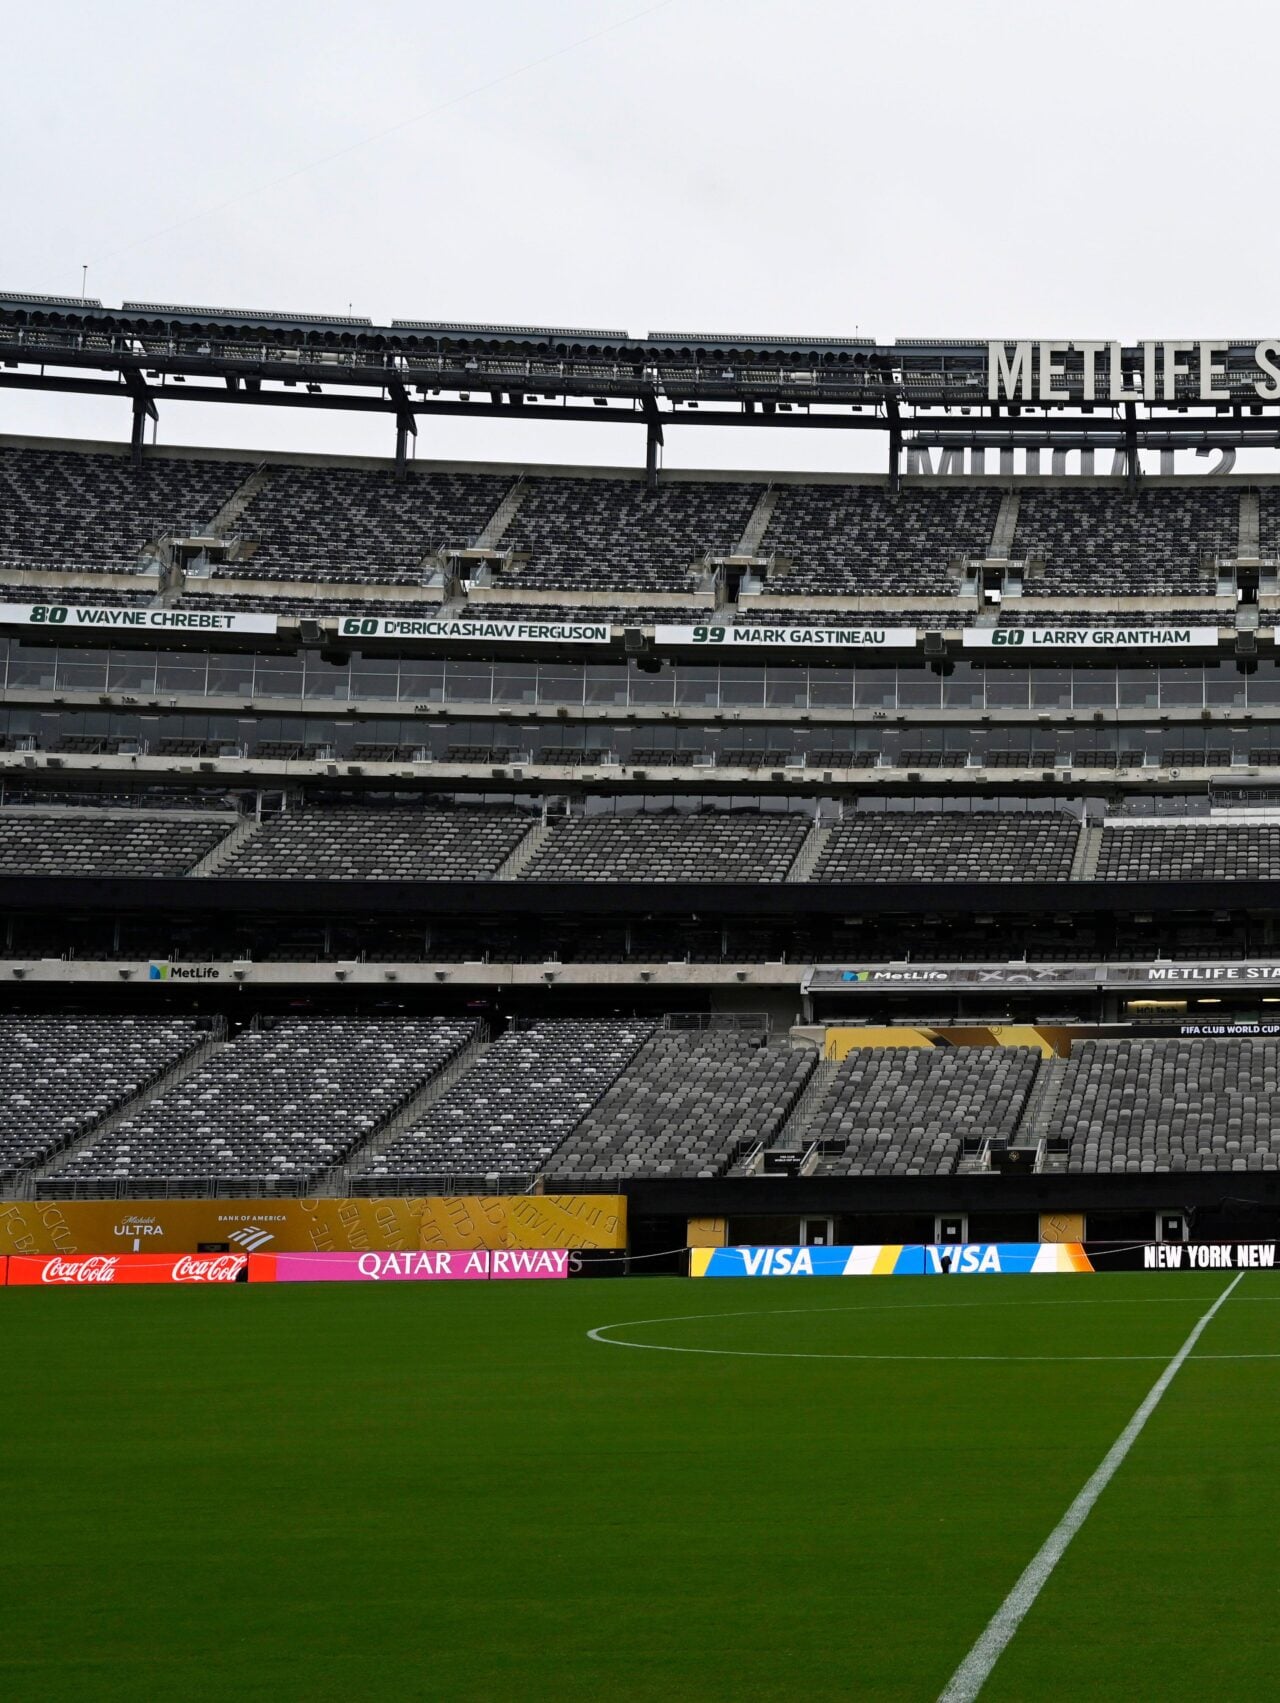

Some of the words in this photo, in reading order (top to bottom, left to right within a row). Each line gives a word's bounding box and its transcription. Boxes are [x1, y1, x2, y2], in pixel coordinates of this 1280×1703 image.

[987, 341, 1229, 400] METLIFE
[29, 606, 68, 623] 80
[76, 608, 147, 626] WAYNE
[151, 612, 235, 629] CHREBET
[343, 618, 378, 635] 60
[384, 620, 514, 638] D'BRICKASHAW
[518, 623, 607, 641] FERGUSON
[692, 626, 725, 643] 99
[733, 629, 786, 644] MARK
[790, 629, 885, 645] GASTINEAU
[991, 629, 1023, 645] 60
[1032, 630, 1088, 645] LARRY
[1092, 629, 1190, 645] GRANTHAM
[170, 967, 219, 979] MetLife
[873, 971, 947, 981] MetLife
[1148, 968, 1239, 979] METLIFE
[1181, 1026, 1200, 1034] FIFA
[1202, 1026, 1225, 1034] CLUB
[1227, 1025, 1260, 1034] WORLD
[1261, 1025, 1280, 1033] CUP
[114, 1225, 163, 1236] ULTRA
[358, 1252, 452, 1280] QATAR
[464, 1250, 583, 1274] AIRWAYS
[736, 1248, 813, 1275] VISA
[927, 1245, 1001, 1273] VISA
[1144, 1245, 1182, 1268] NEW
[1188, 1245, 1232, 1268] YORK
[1237, 1245, 1275, 1267] NEW
[41, 1256, 121, 1283] Coca-Cola
[171, 1255, 248, 1283] Coca-Col
